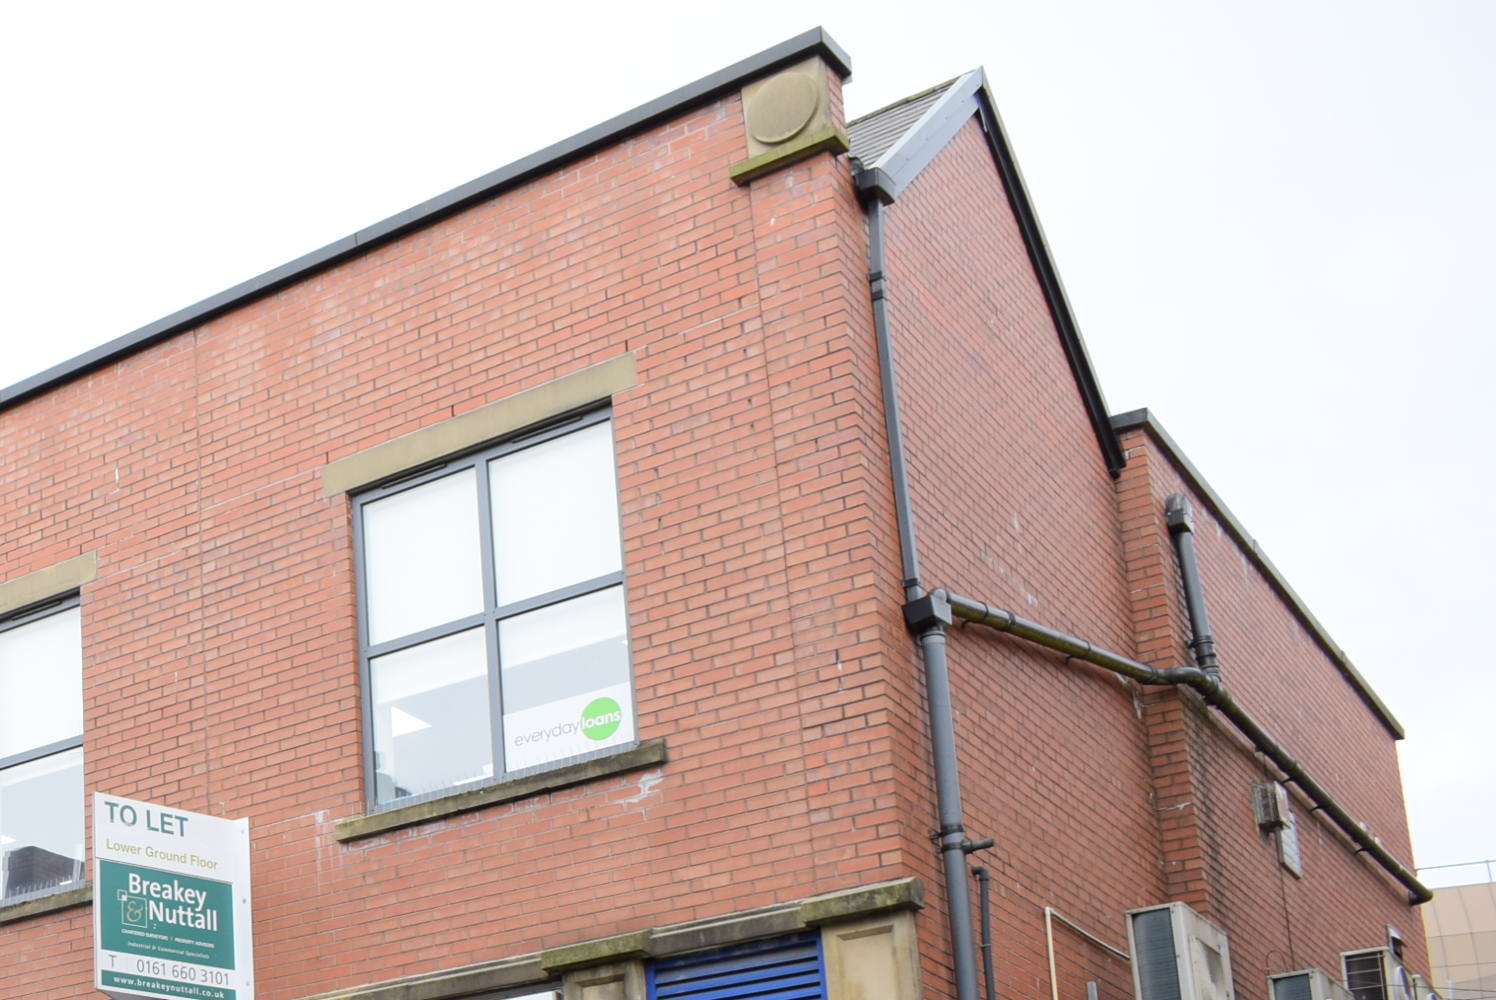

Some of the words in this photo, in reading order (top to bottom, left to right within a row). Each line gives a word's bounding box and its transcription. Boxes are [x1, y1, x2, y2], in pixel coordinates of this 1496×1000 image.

[104, 801, 137, 827] TO
[146, 809, 189, 837] LET
[106, 838, 145, 855] Lower
[145, 846, 187, 864] Ground
[190, 855, 218, 870] Floor
[128, 872, 207, 912] Breakey
[126, 900, 144, 923] &
[148, 900, 218, 931] Nuttall
[108, 954, 117, 969] T
[137, 959, 166, 976] 0161
[172, 965, 196, 981] 660
[201, 968, 229, 986] 3101
[113, 976, 225, 999] www.breakeynuttall.co.uk
